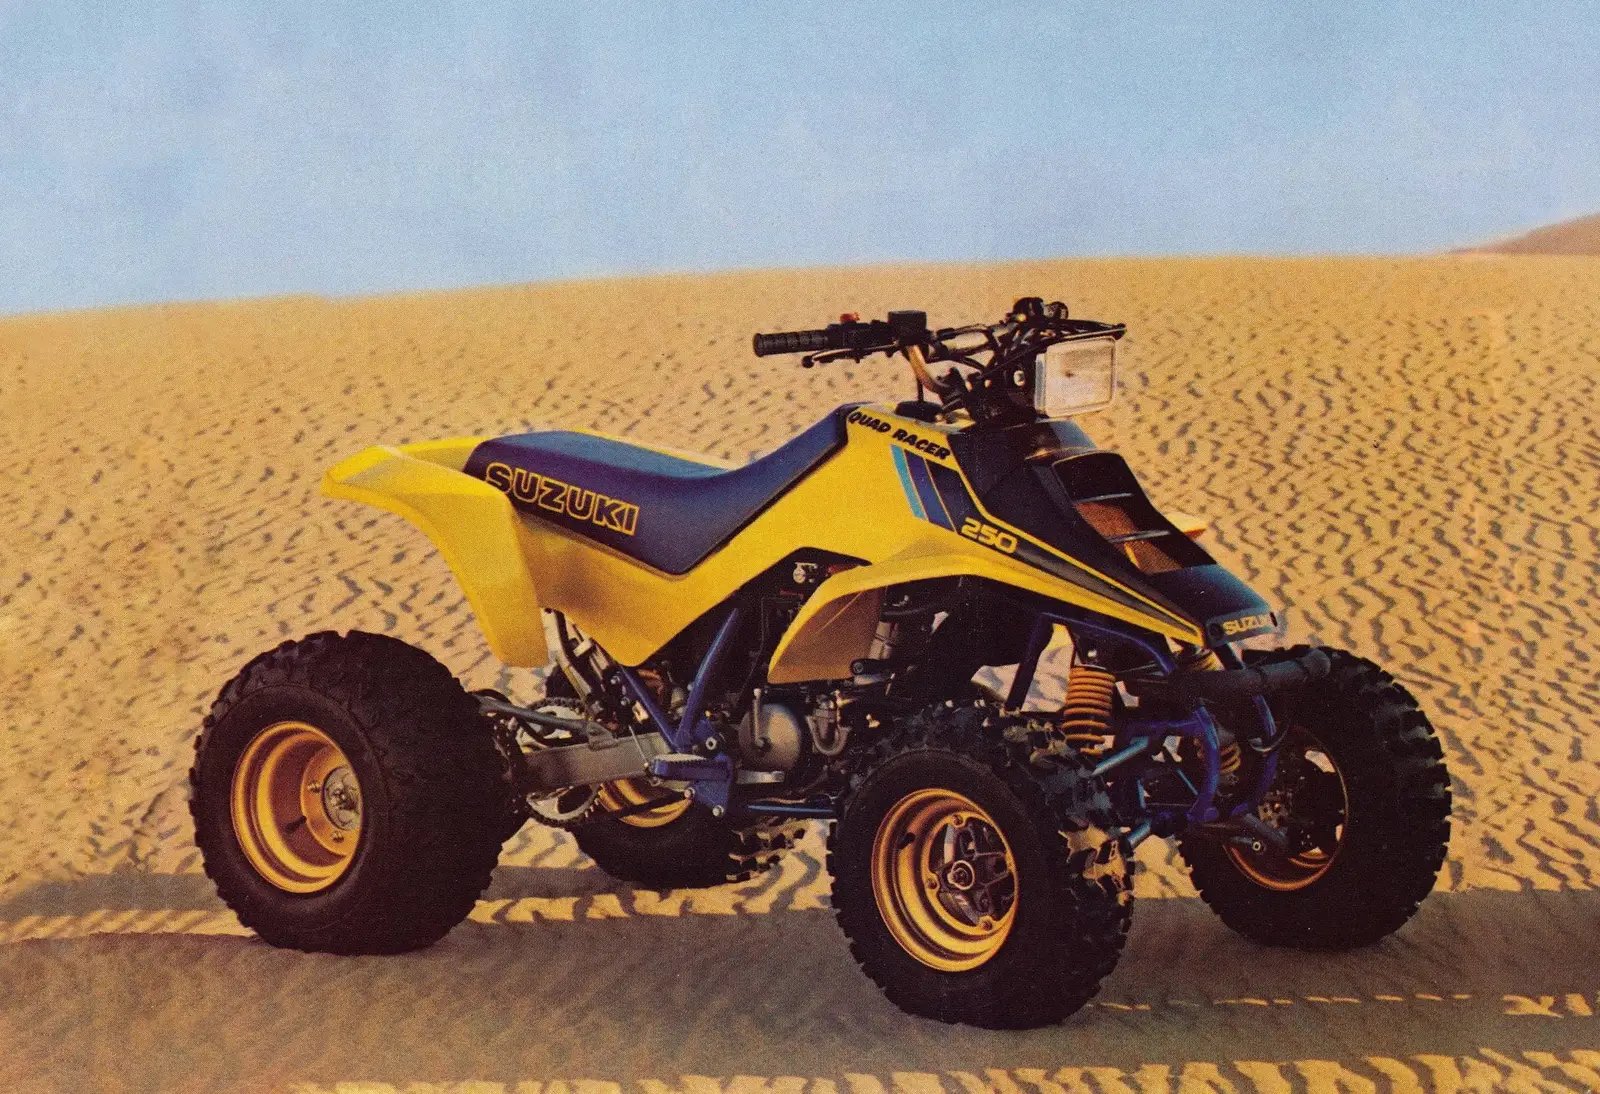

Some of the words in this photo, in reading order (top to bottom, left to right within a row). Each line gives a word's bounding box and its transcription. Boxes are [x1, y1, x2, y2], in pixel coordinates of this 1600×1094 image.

[849, 411, 891, 433] QUAD
[892, 429, 951, 460] RACER
[485, 462, 640, 536] SUZUKI
[961, 517, 1018, 554] 250
[1222, 613, 1269, 636] SUZU
